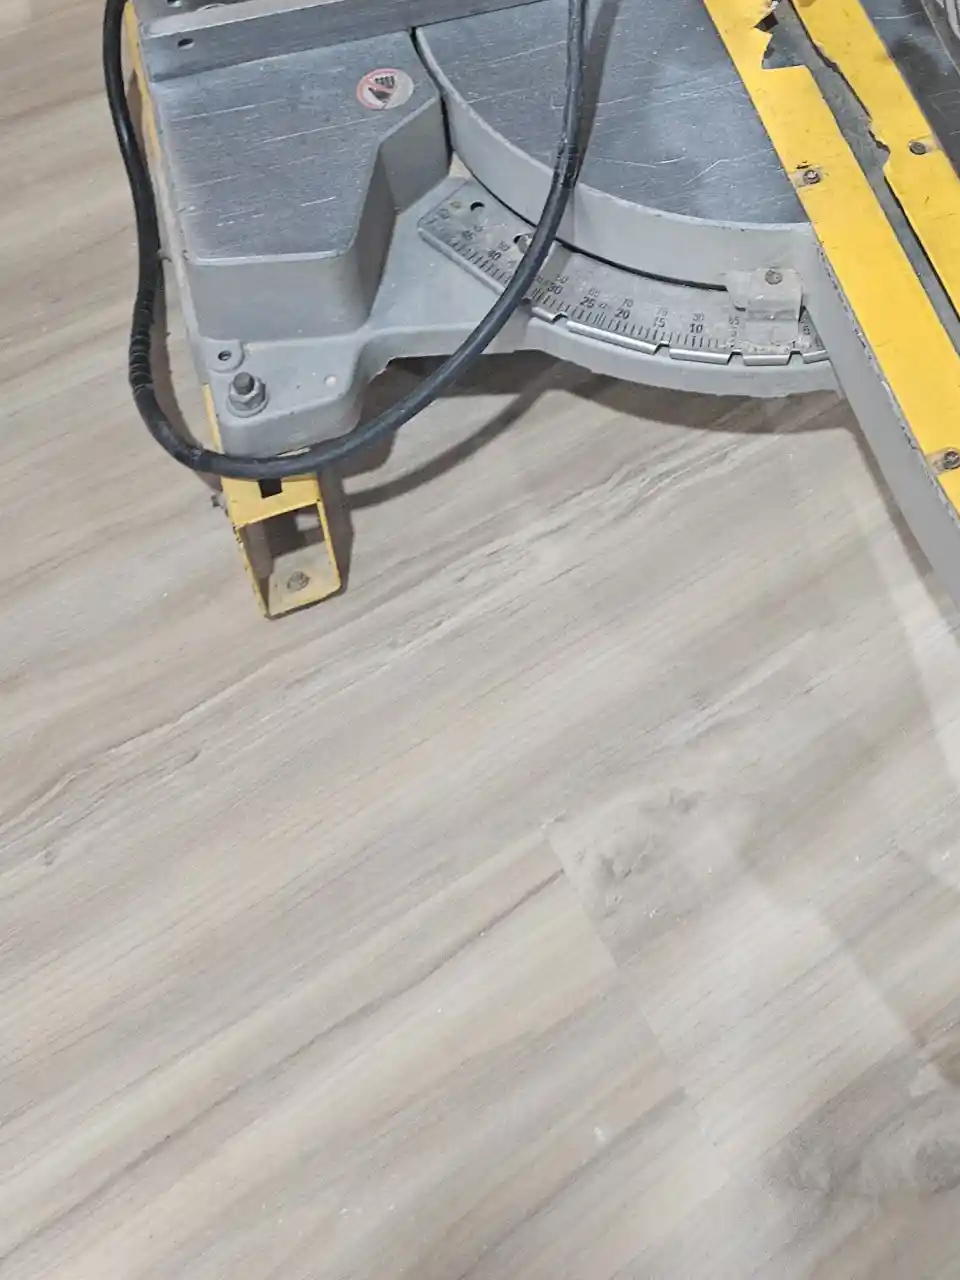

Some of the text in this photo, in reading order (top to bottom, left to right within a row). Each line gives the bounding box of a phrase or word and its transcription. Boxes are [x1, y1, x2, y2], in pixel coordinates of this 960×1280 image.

[548, 282, 563, 295] 30
[580, 296, 596, 309] 25
[614, 308, 631, 319] 20
[689, 323, 703, 333] 10
